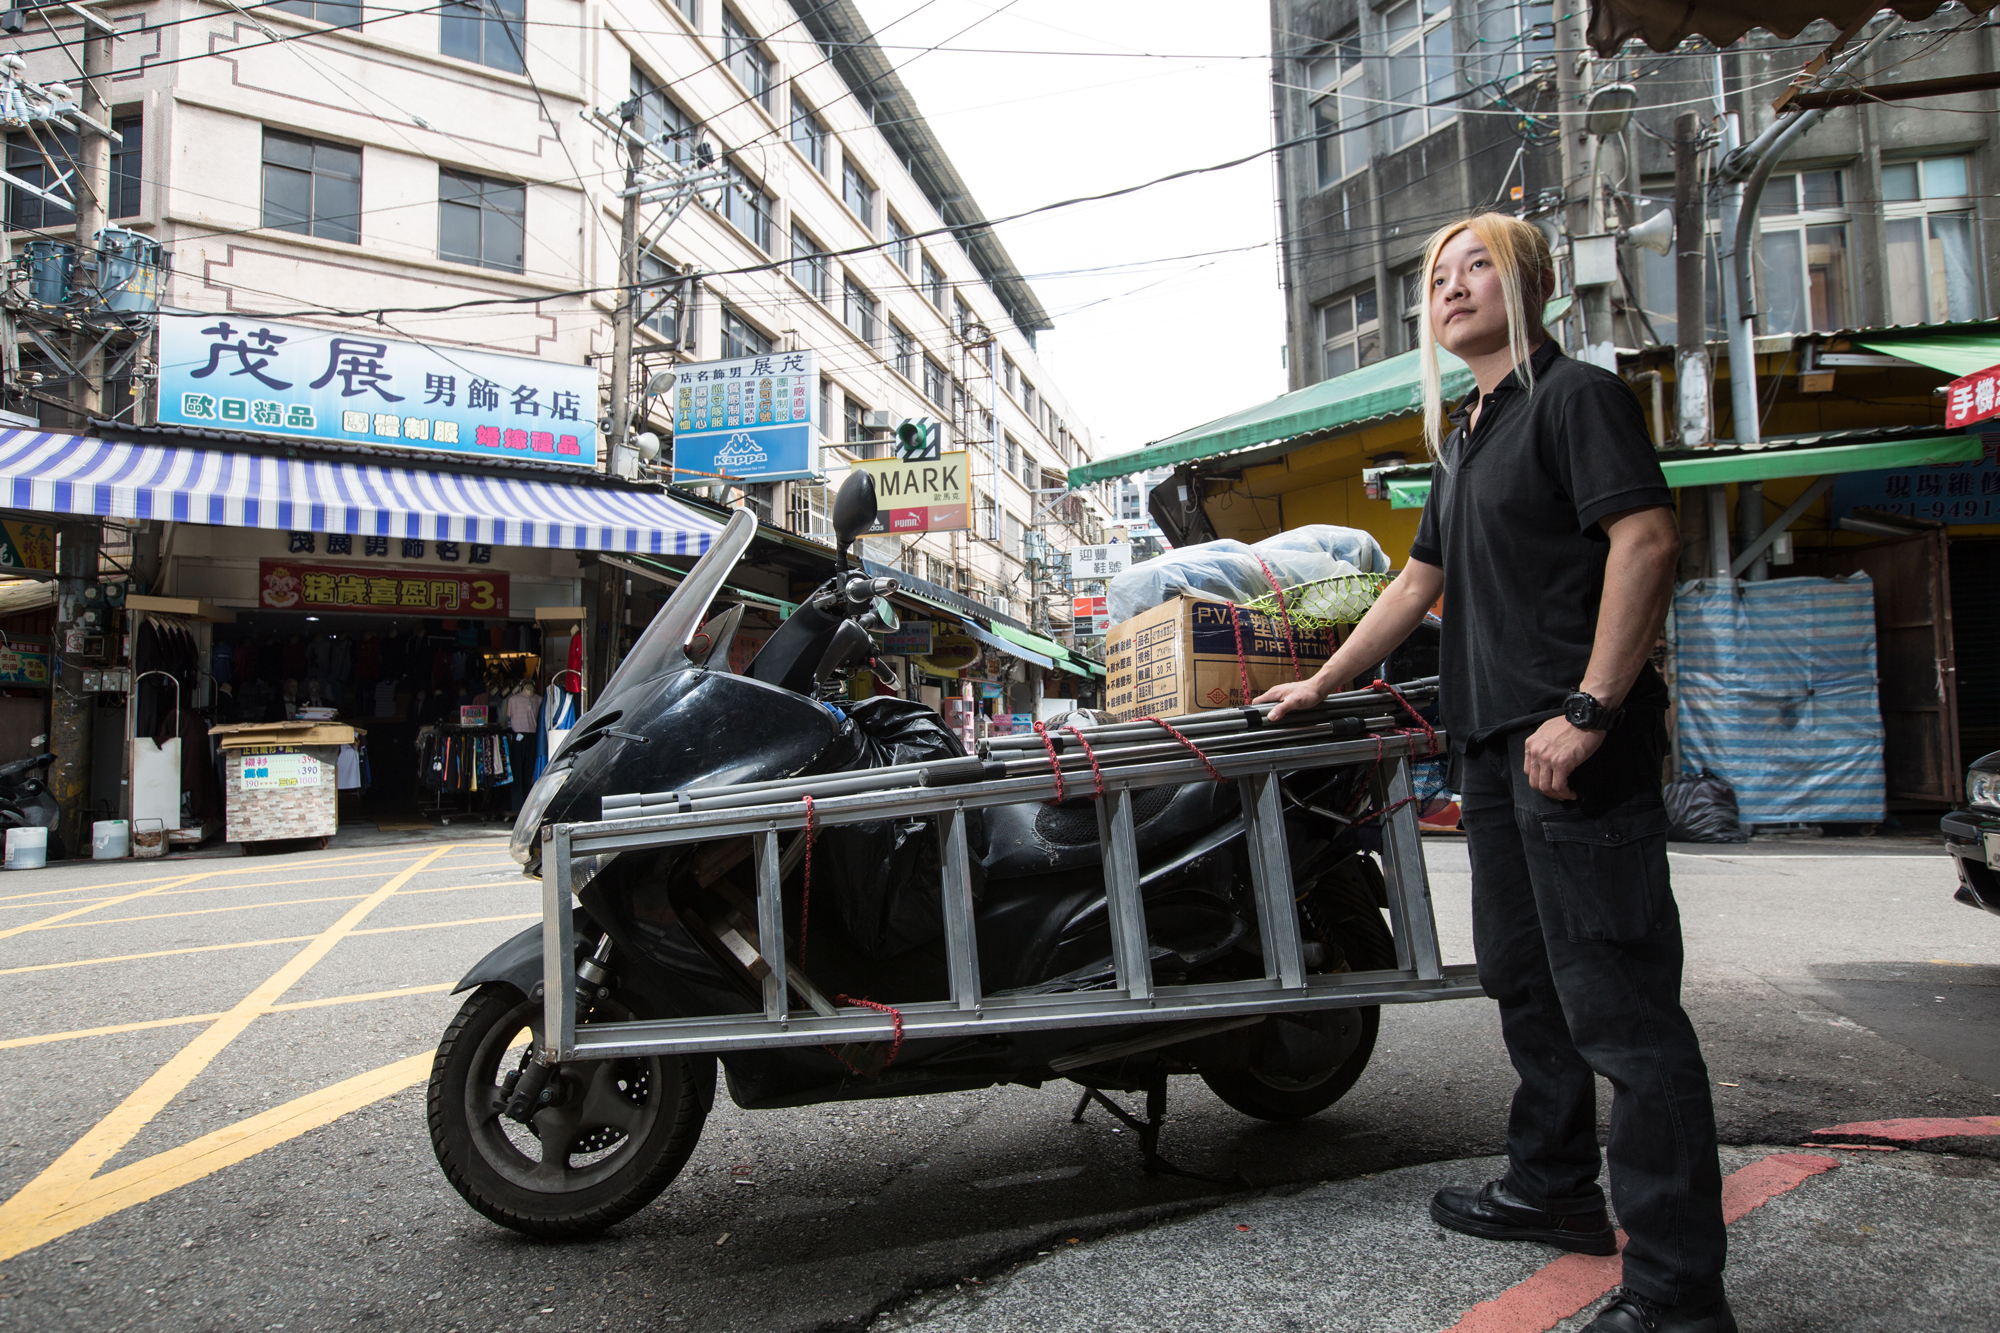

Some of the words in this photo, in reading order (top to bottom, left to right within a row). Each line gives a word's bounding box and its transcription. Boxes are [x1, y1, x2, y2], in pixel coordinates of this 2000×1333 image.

[190, 321, 406, 403] 茂展
[423, 372, 580, 422] 男飾名店
[711, 383, 724, 428] 巡守隊服
[759, 377, 773, 423] 公司行號
[776, 377, 789, 421] 團體制服
[793, 375, 805, 420] 工廠直營
[678, 386, 692, 431] 活動T恤
[695, 386, 708, 430] 選舉背心
[182, 393, 317, 430] 歐日精品
[475, 424, 580, 456] 婚嫁禮品
[714, 453, 768, 466] Kappa
[934, 492, 960, 502] 歐馬克
[1857, 501, 2000, 519] 21-9491
[894, 518, 917, 528] PUMA
[288, 532, 492, 564] 茂展男飾名店
[1080, 548, 1107, 561] 迎豐
[1094, 561, 1122, 573] 鞋號
[460, 582, 469, 599] 全面
[470, 581, 494, 610] 3
[1138, 633, 1149, 647] 品名
[1254, 639, 1286, 653] PIPE
[1293, 641, 1330, 656] FITTIN
[1138, 649, 1150, 663] 規格
[1138, 666, 1151, 681] 數量
[1166, 661, 1172, 673] 只
[245, 780, 259, 788] 390
[299, 777, 318, 785] 1000
